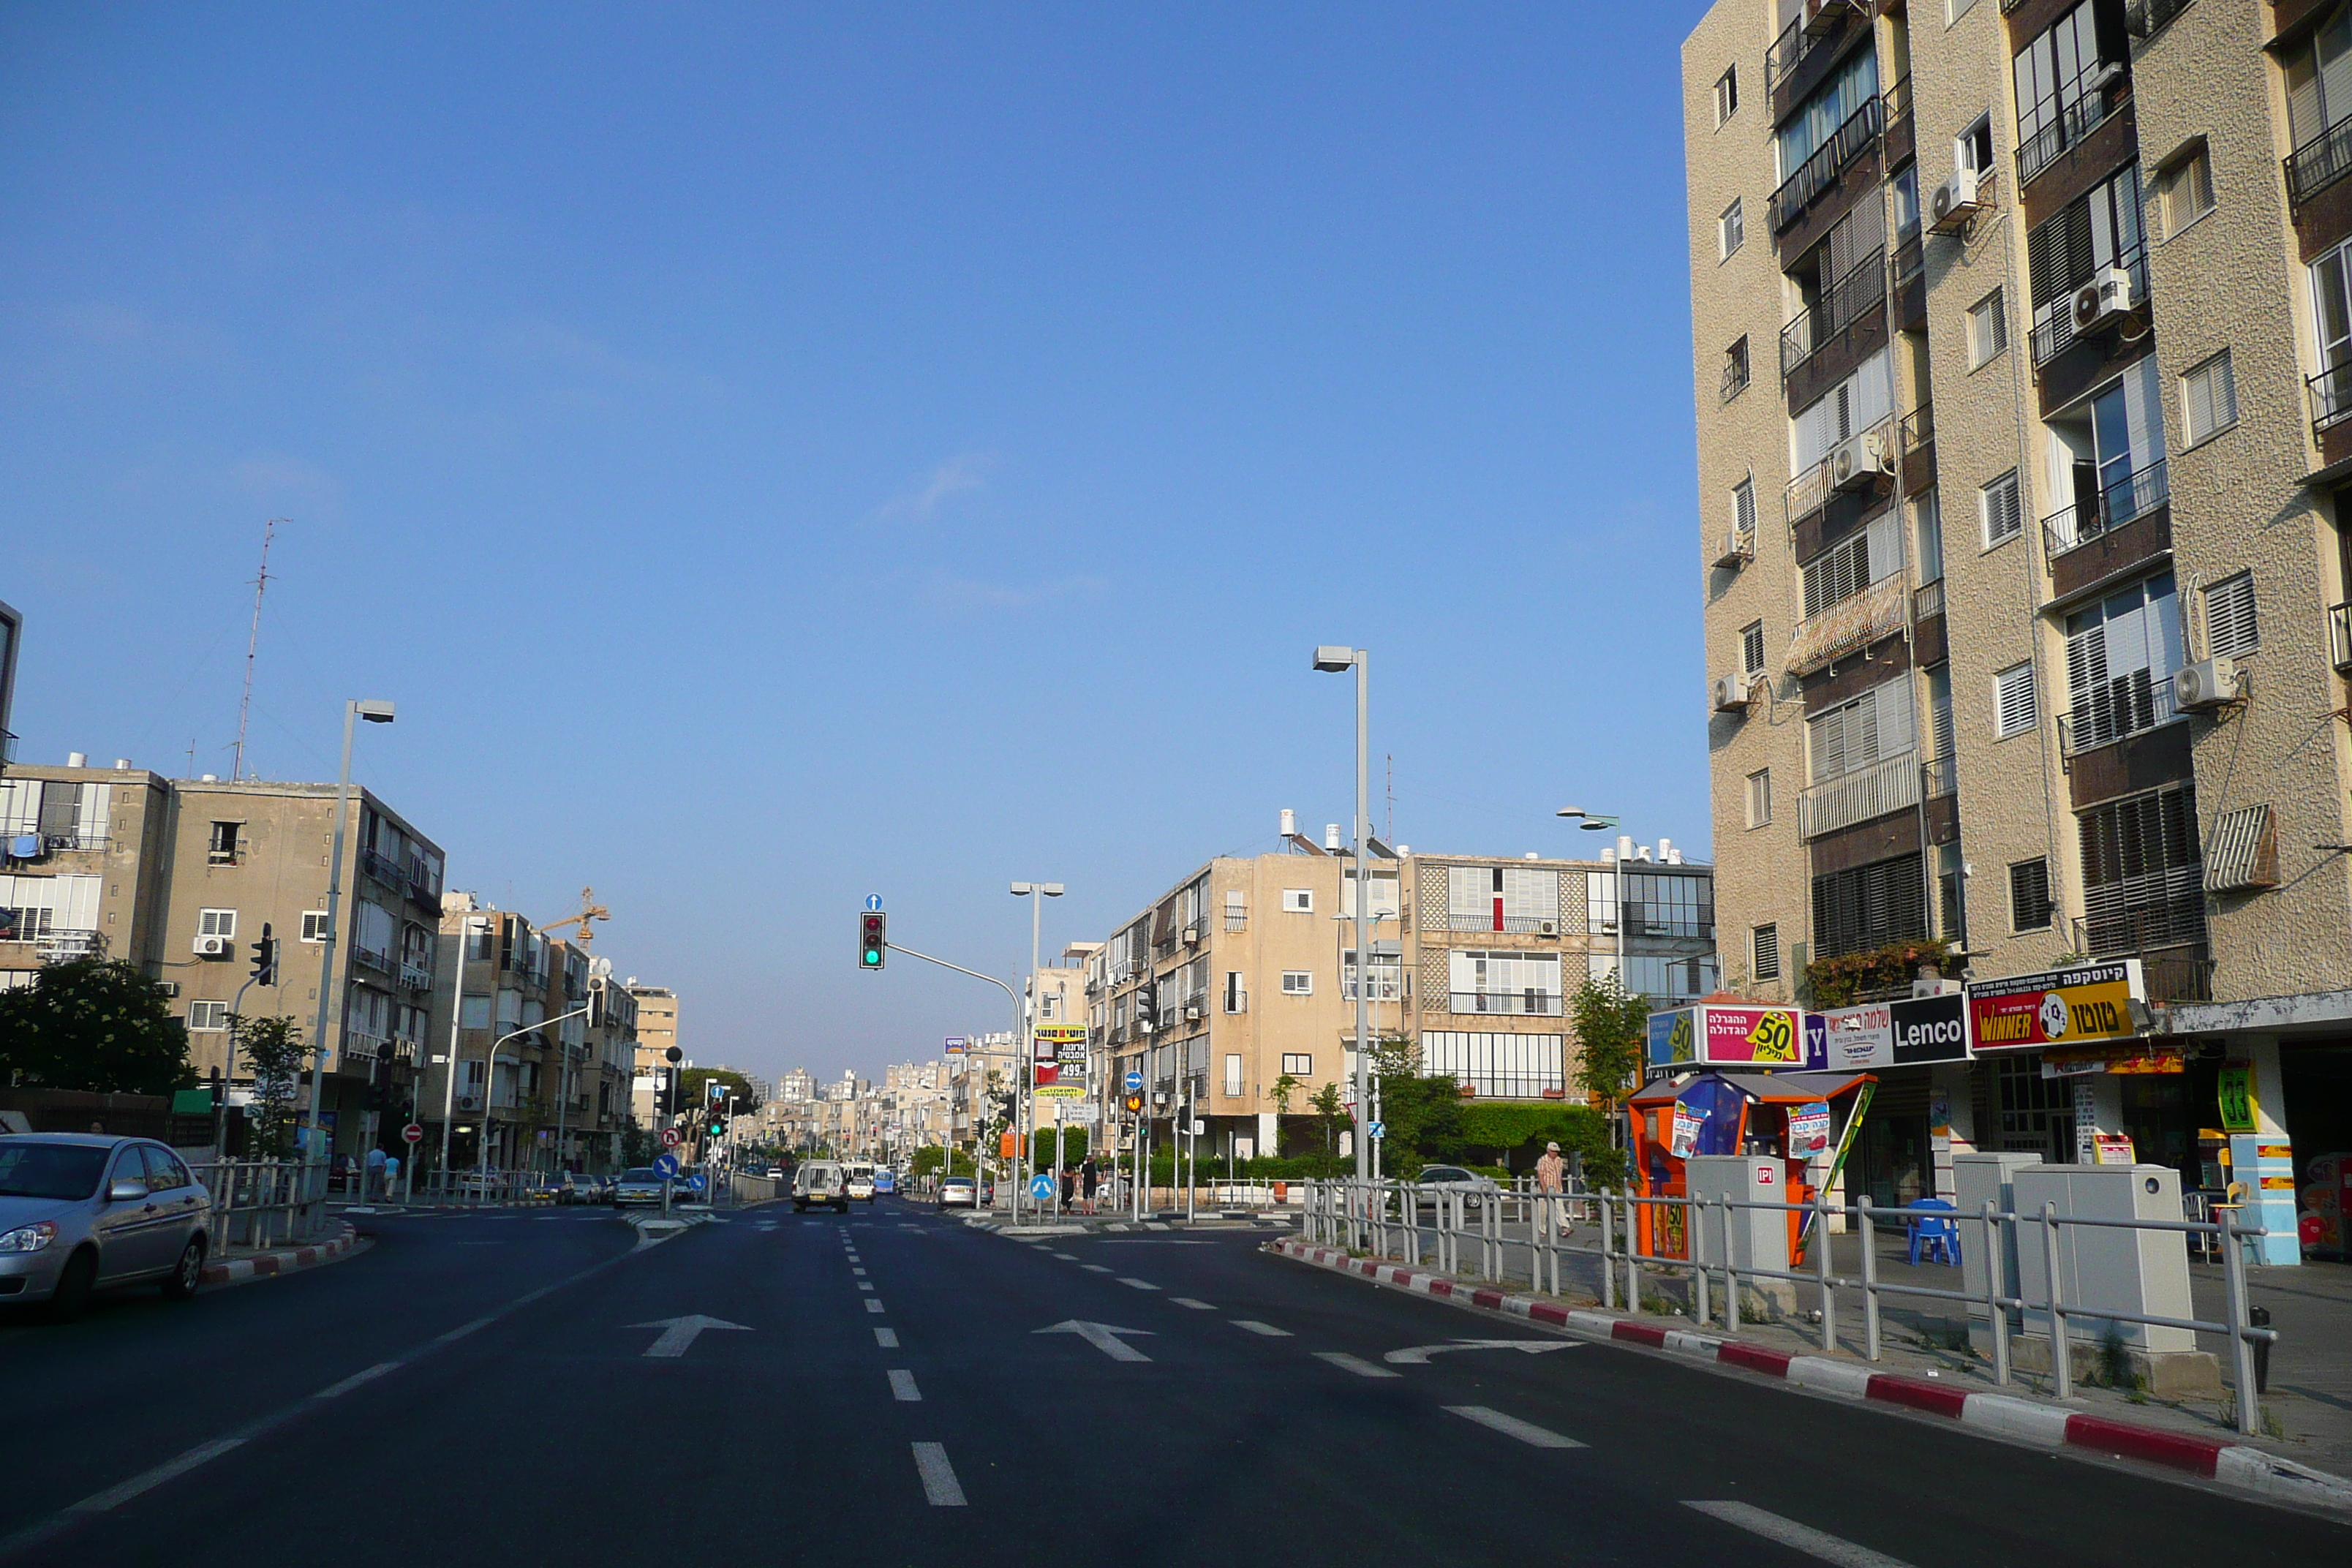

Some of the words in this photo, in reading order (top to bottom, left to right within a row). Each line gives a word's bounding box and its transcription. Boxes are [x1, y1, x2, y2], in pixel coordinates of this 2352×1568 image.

[2062, 966, 2125, 986] קיוסקפה
[1708, 1013, 1747, 1025] ההגרלה
[1864, 1007, 1889, 1030] שלמה
[1978, 1003, 2032, 1043] WINNER
[2070, 1000, 2120, 1035] טוטו
[1673, 1017, 1691, 1050] 50
[1709, 1025, 1748, 1036] הגדולה
[1756, 1017, 1790, 1050] 50
[1894, 1019, 1961, 1047] Lenco
[1063, 1063, 1080, 1077] 499
[1759, 1169, 1772, 1181] IPI
[1669, 1205, 1681, 1225] 50
